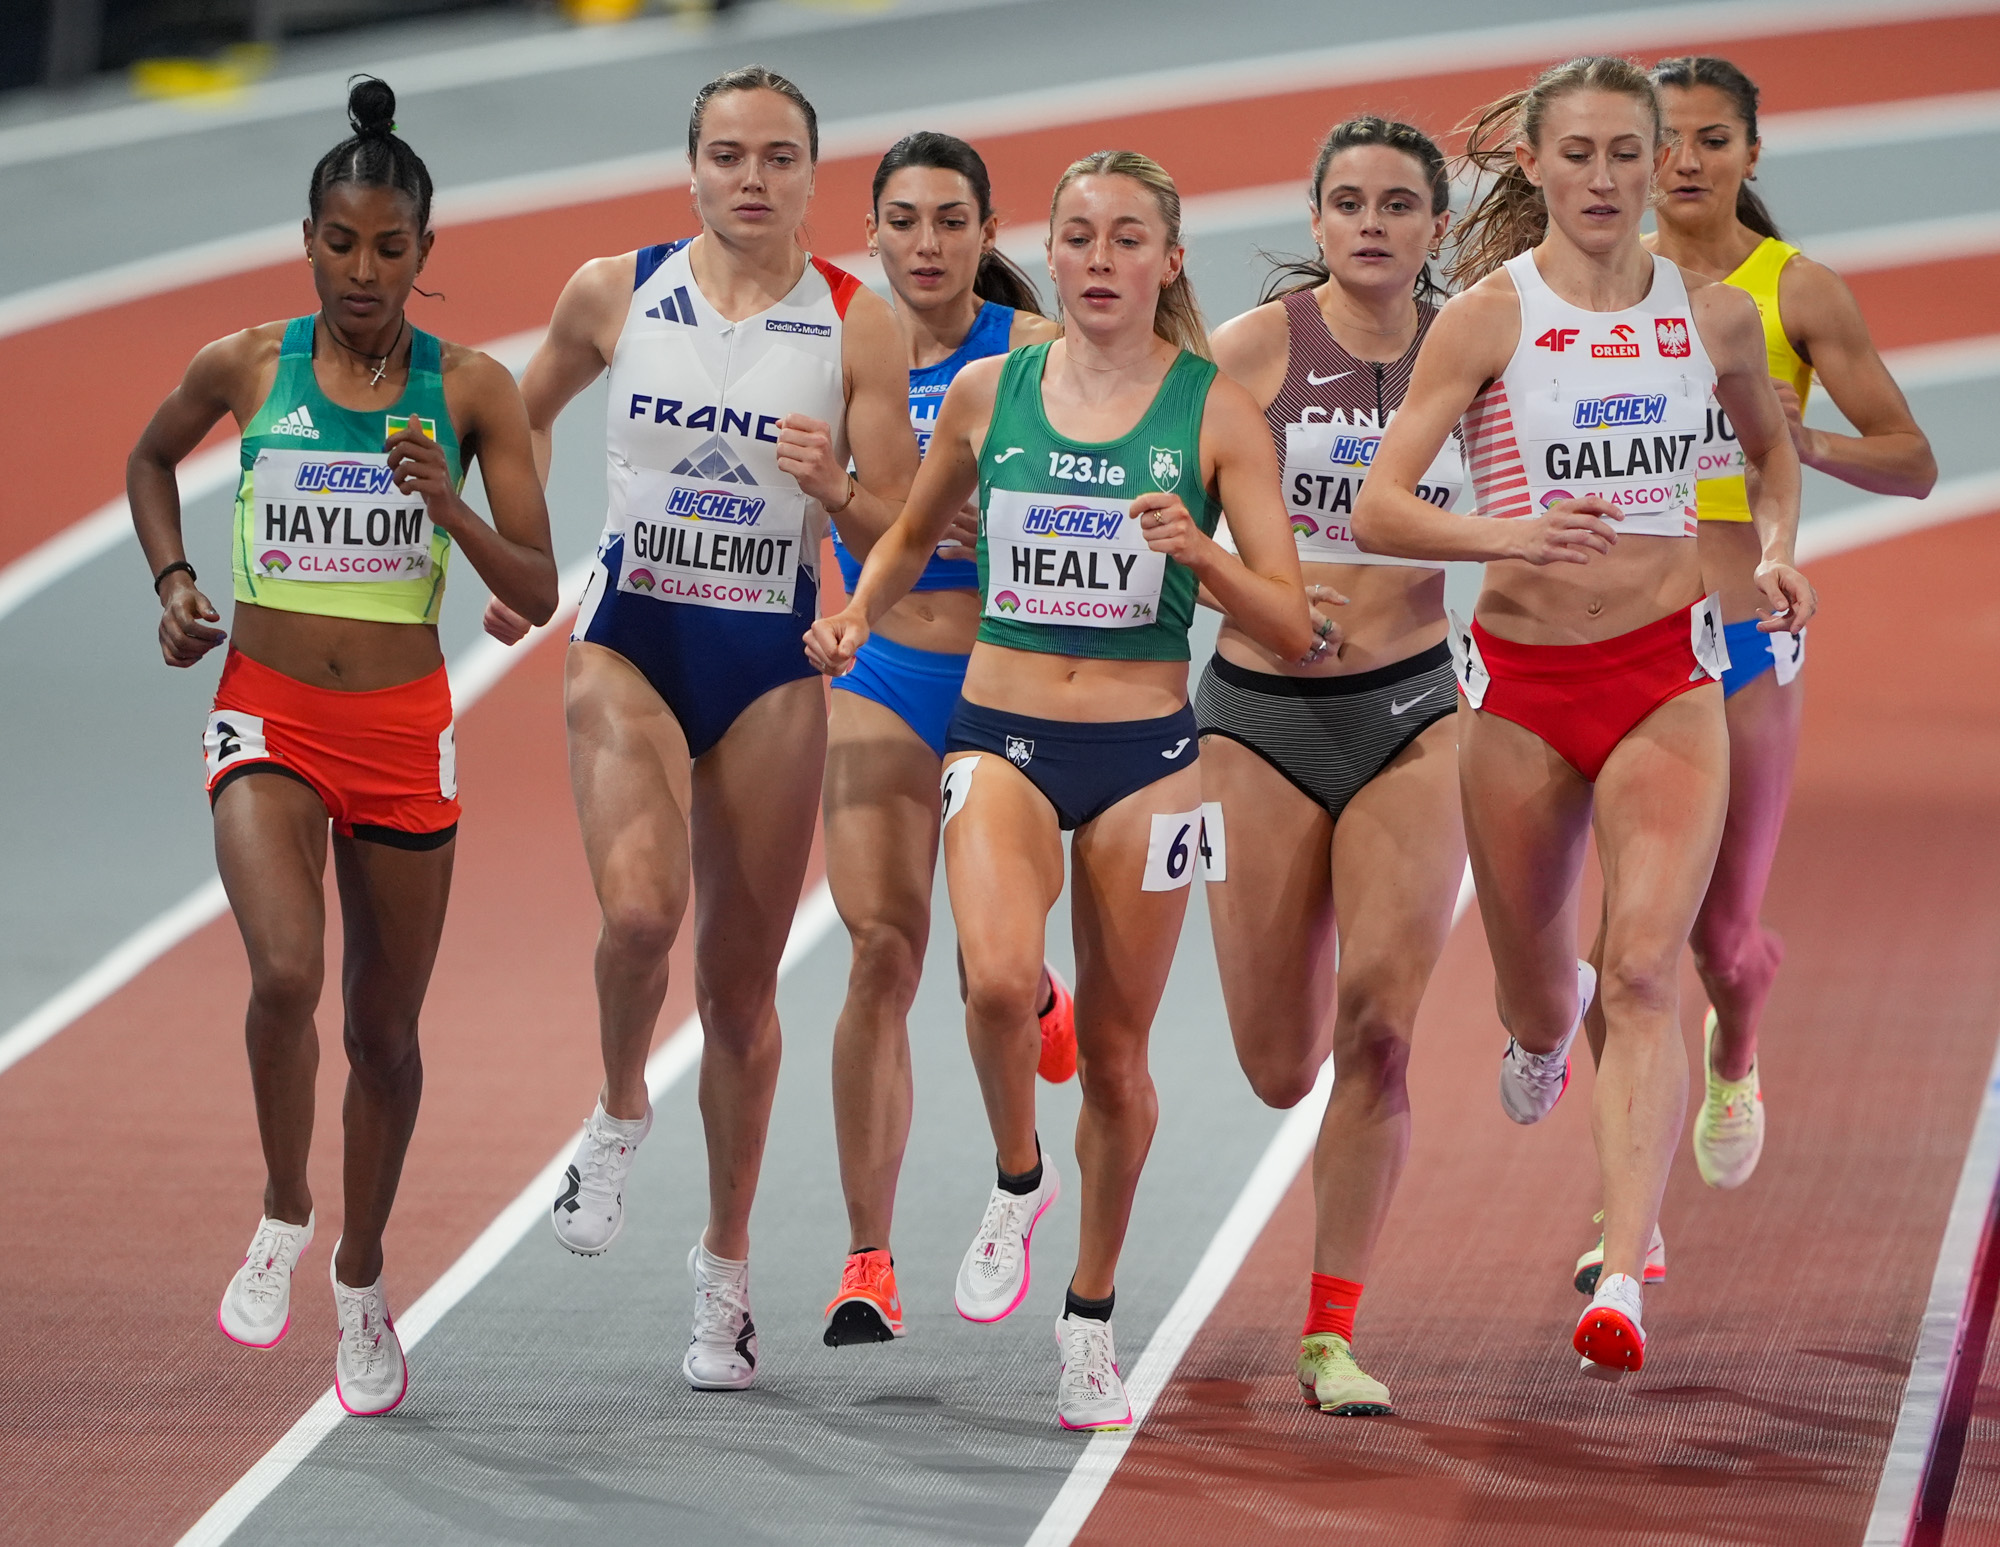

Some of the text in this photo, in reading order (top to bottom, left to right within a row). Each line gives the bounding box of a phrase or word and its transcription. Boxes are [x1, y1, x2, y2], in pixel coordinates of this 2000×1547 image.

[802, 325, 831, 337] Mutuel
[1535, 328, 1580, 352] 4F
[1593, 346, 1637, 357] ORLEN
[629, 393, 781, 443] FRANC
[1573, 393, 1667, 429] HI-CHEW
[271, 423, 320, 440] adidas
[1049, 451, 1126, 486] 123.ie
[1545, 434, 1697, 481] GALANT
[295, 462, 395, 494] HI-CHEW
[1675, 482, 1689, 499] 24
[665, 486, 765, 526] HI-CHEW
[1023, 504, 1123, 540] HI-CHEW
[265, 504, 425, 547] HAYLOM
[298, 555, 425, 573] GLASGOW 24
[633, 521, 792, 577] GUILLEMOT
[1011, 545, 1138, 591] HEALY
[661, 578, 787, 605] GLASGOW 24
[1025, 598, 1152, 618] GLASGOW 24
[216, 721, 241, 762] 2
[1166, 823, 1191, 879] 6
